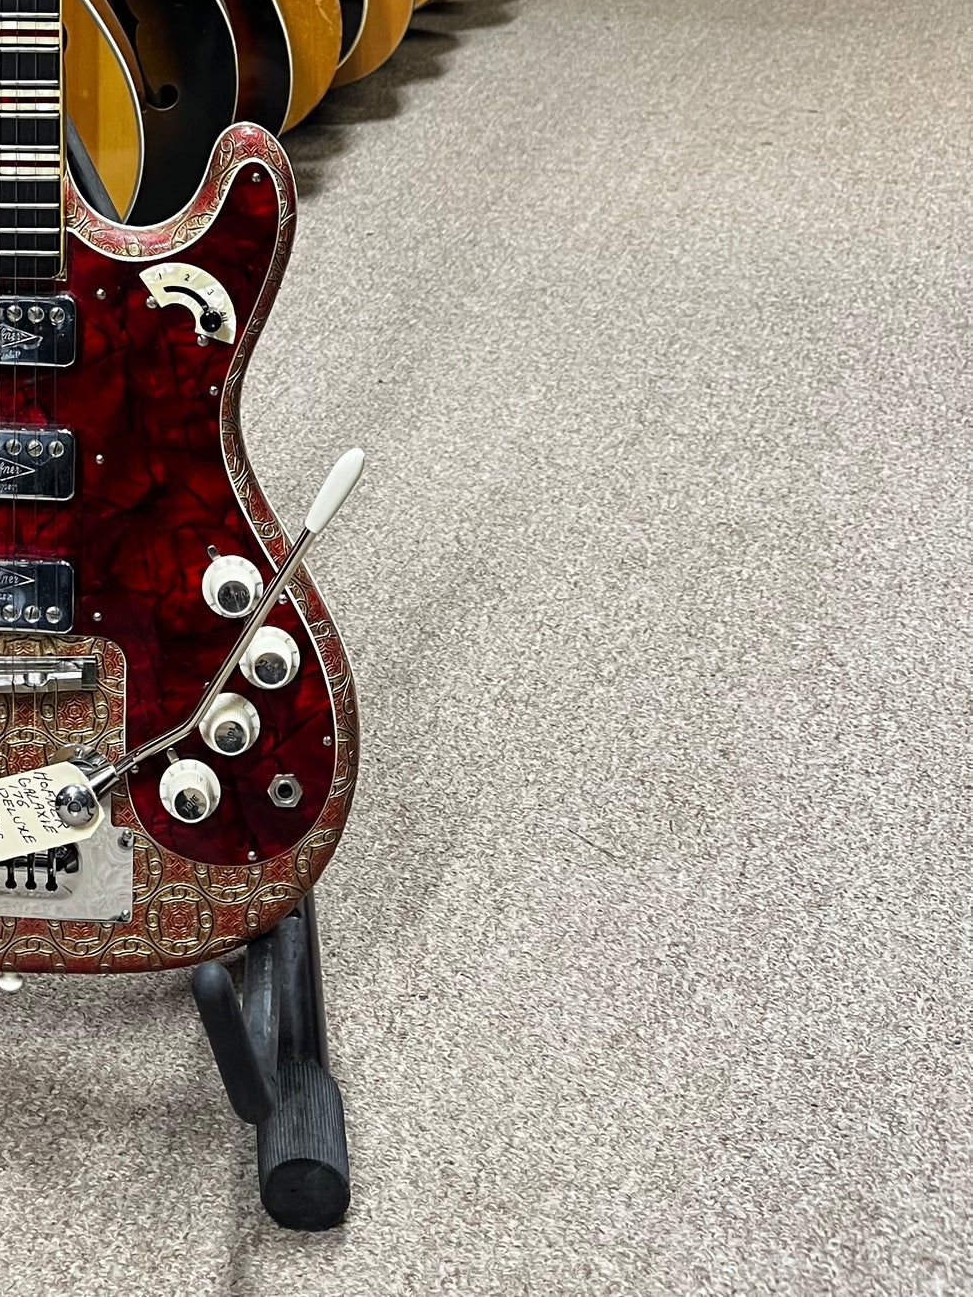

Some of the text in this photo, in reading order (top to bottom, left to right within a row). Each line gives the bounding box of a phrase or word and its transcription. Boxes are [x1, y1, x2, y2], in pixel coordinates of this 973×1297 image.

[184, 274, 190, 282] 2
[207, 288, 215, 296] 3
[8, 785, 30, 808] 176
[17, 777, 59, 834] GALAXIE
